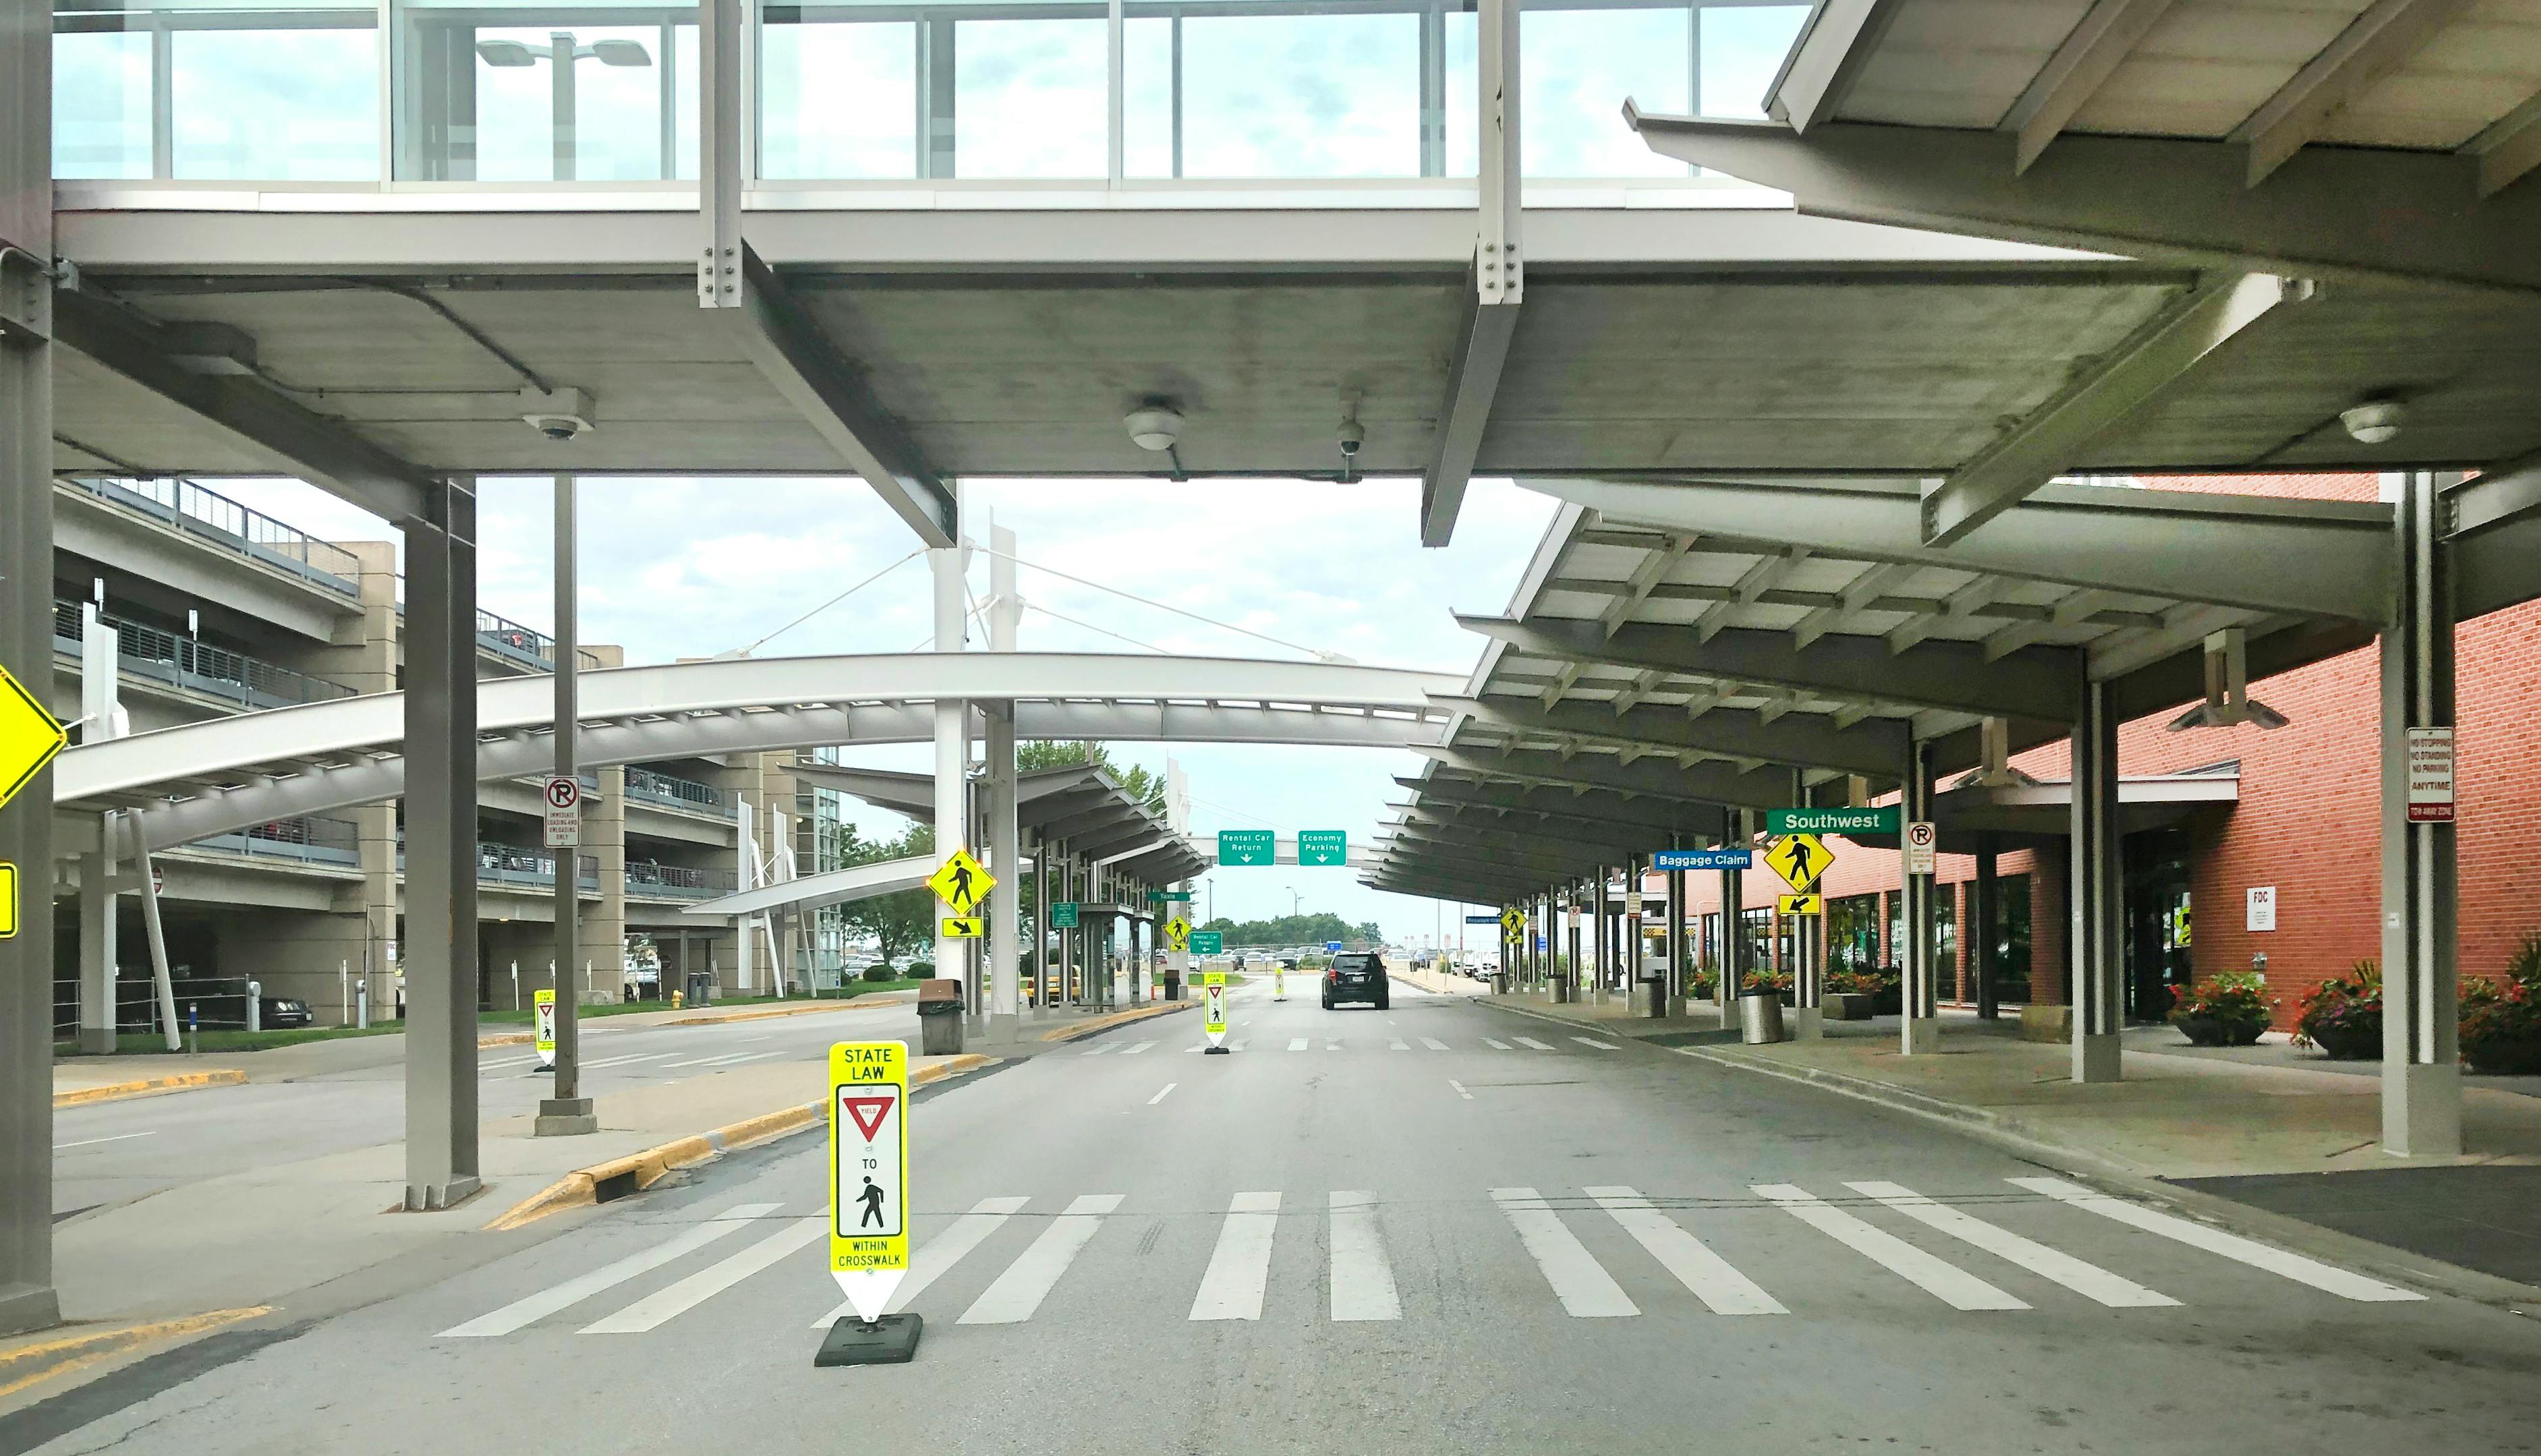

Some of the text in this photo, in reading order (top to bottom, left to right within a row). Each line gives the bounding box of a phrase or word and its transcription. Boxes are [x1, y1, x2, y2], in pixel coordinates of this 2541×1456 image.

[2412, 764, 2421, 773] NO
[2411, 782, 2451, 790] ANYTIME
[1786, 814, 1879, 829] Southwest
[1303, 834, 1342, 843] Economy
[1305, 844, 1340, 853] Parking
[1659, 854, 1748, 867] Baggage Claim
[2254, 891, 2268, 903] FDC
[845, 1049, 892, 1064] STATE
[852, 1066, 884, 1080] LAW
[862, 1159, 877, 1169] TO
[853, 1240, 888, 1252] WITHIN
[838, 1255, 901, 1266] CROSSWALK
